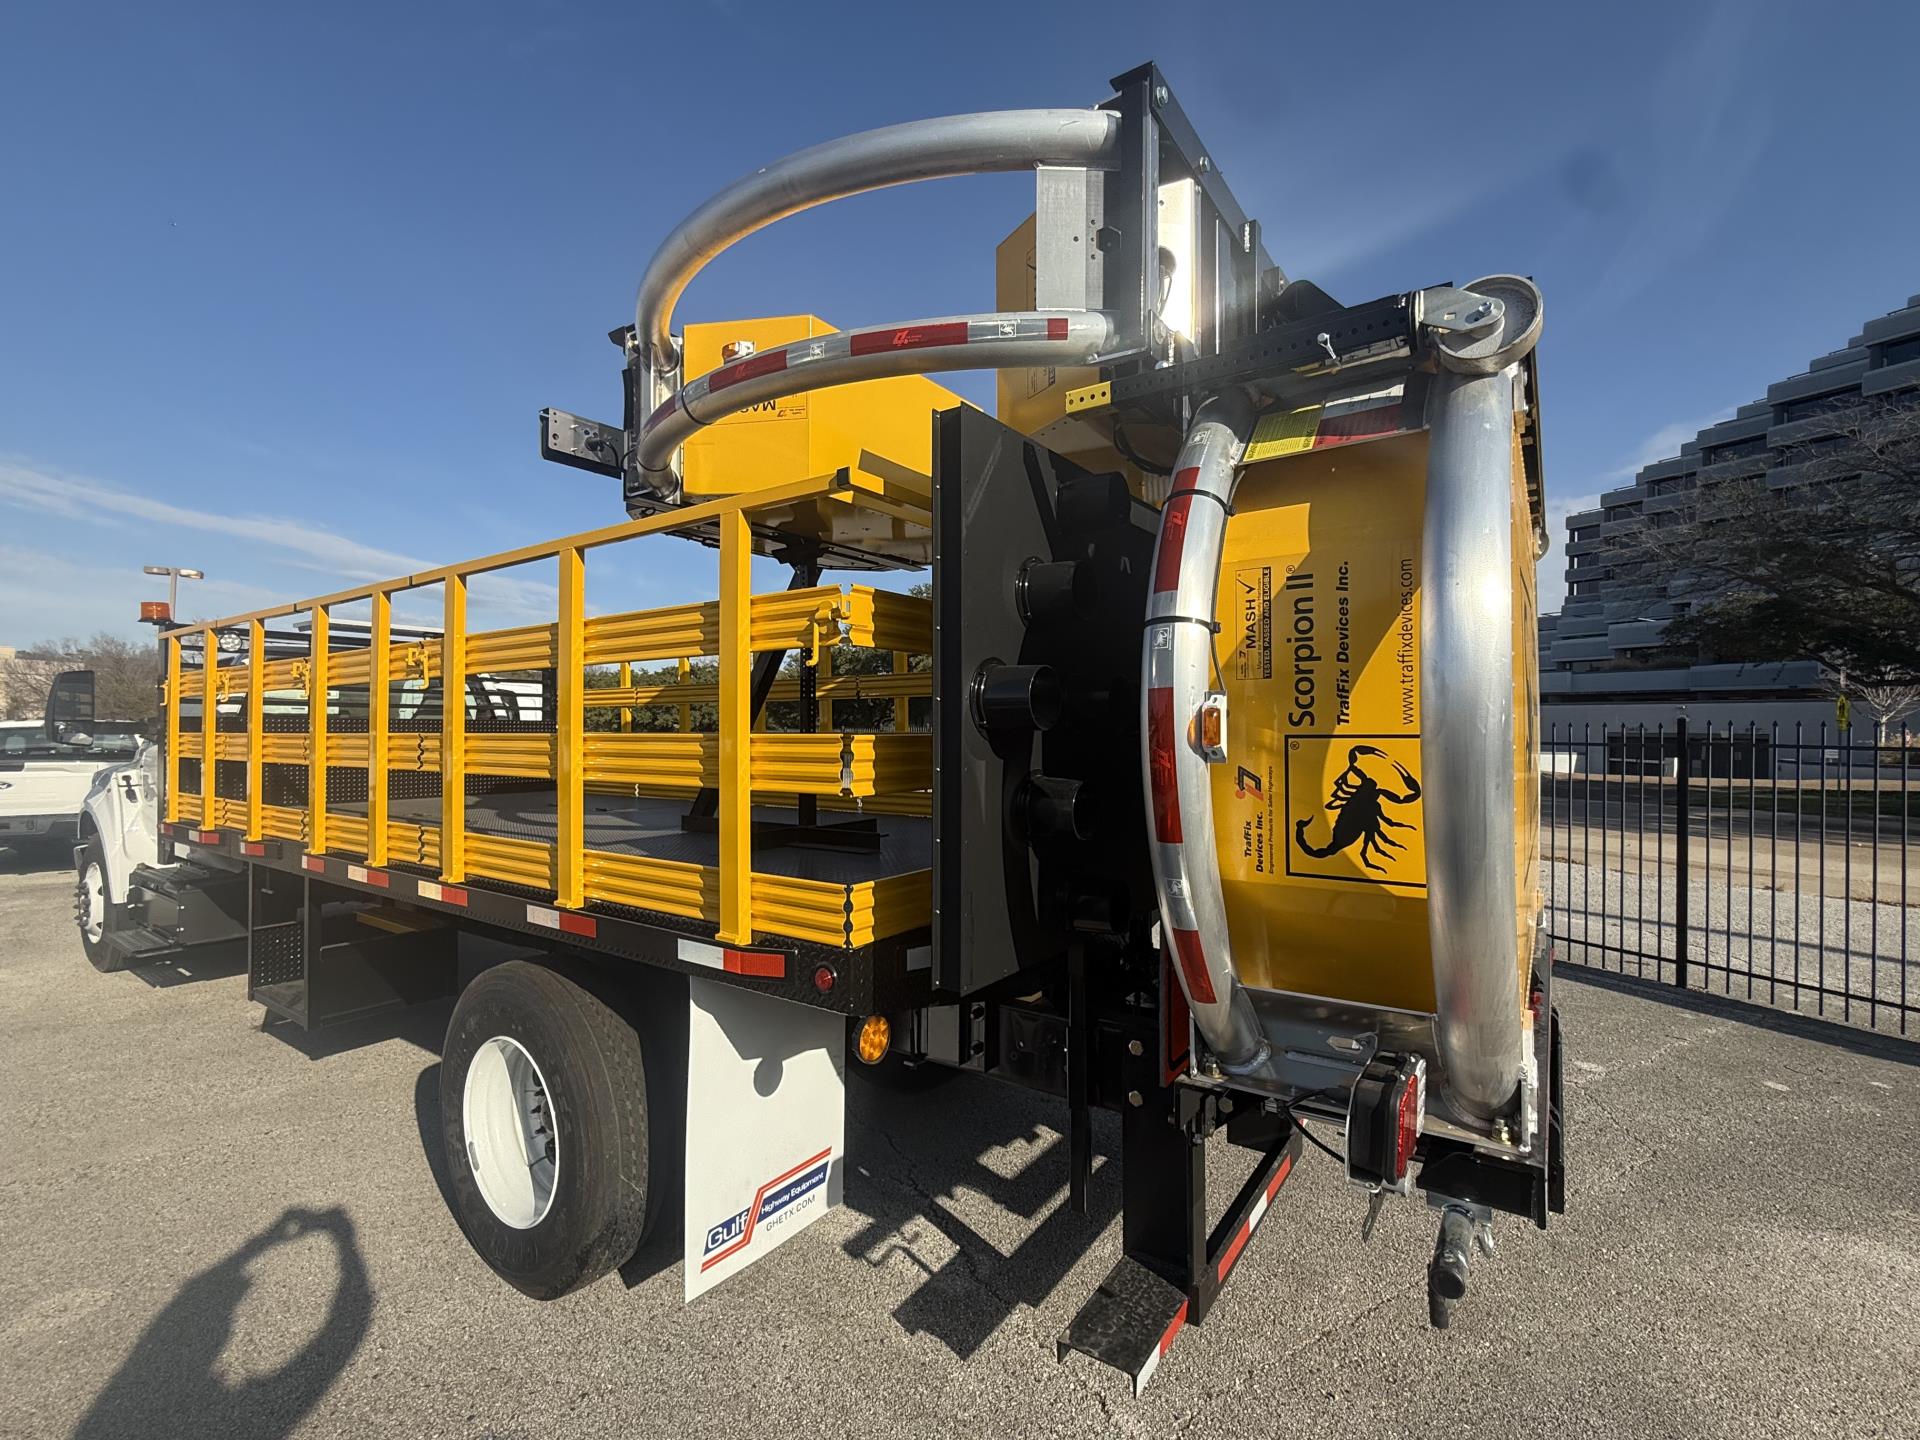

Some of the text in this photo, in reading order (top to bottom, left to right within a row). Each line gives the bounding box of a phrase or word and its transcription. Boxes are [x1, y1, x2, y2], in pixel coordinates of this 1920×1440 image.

[1245, 599, 1257, 649] MASH
[1336, 560, 1350, 726] TrafFix Devices Inc.
[1397, 558, 1415, 726] www.traffixdevices.com
[1287, 594, 1322, 727] Scorpion
[1243, 820, 1252, 858] TrafFix
[1255, 811, 1264, 873] Devices Inc.
[761, 1172, 824, 1215] Highway Equipment
[766, 1194, 816, 1232] GHETX.COM
[707, 1211, 749, 1249] Gulf
